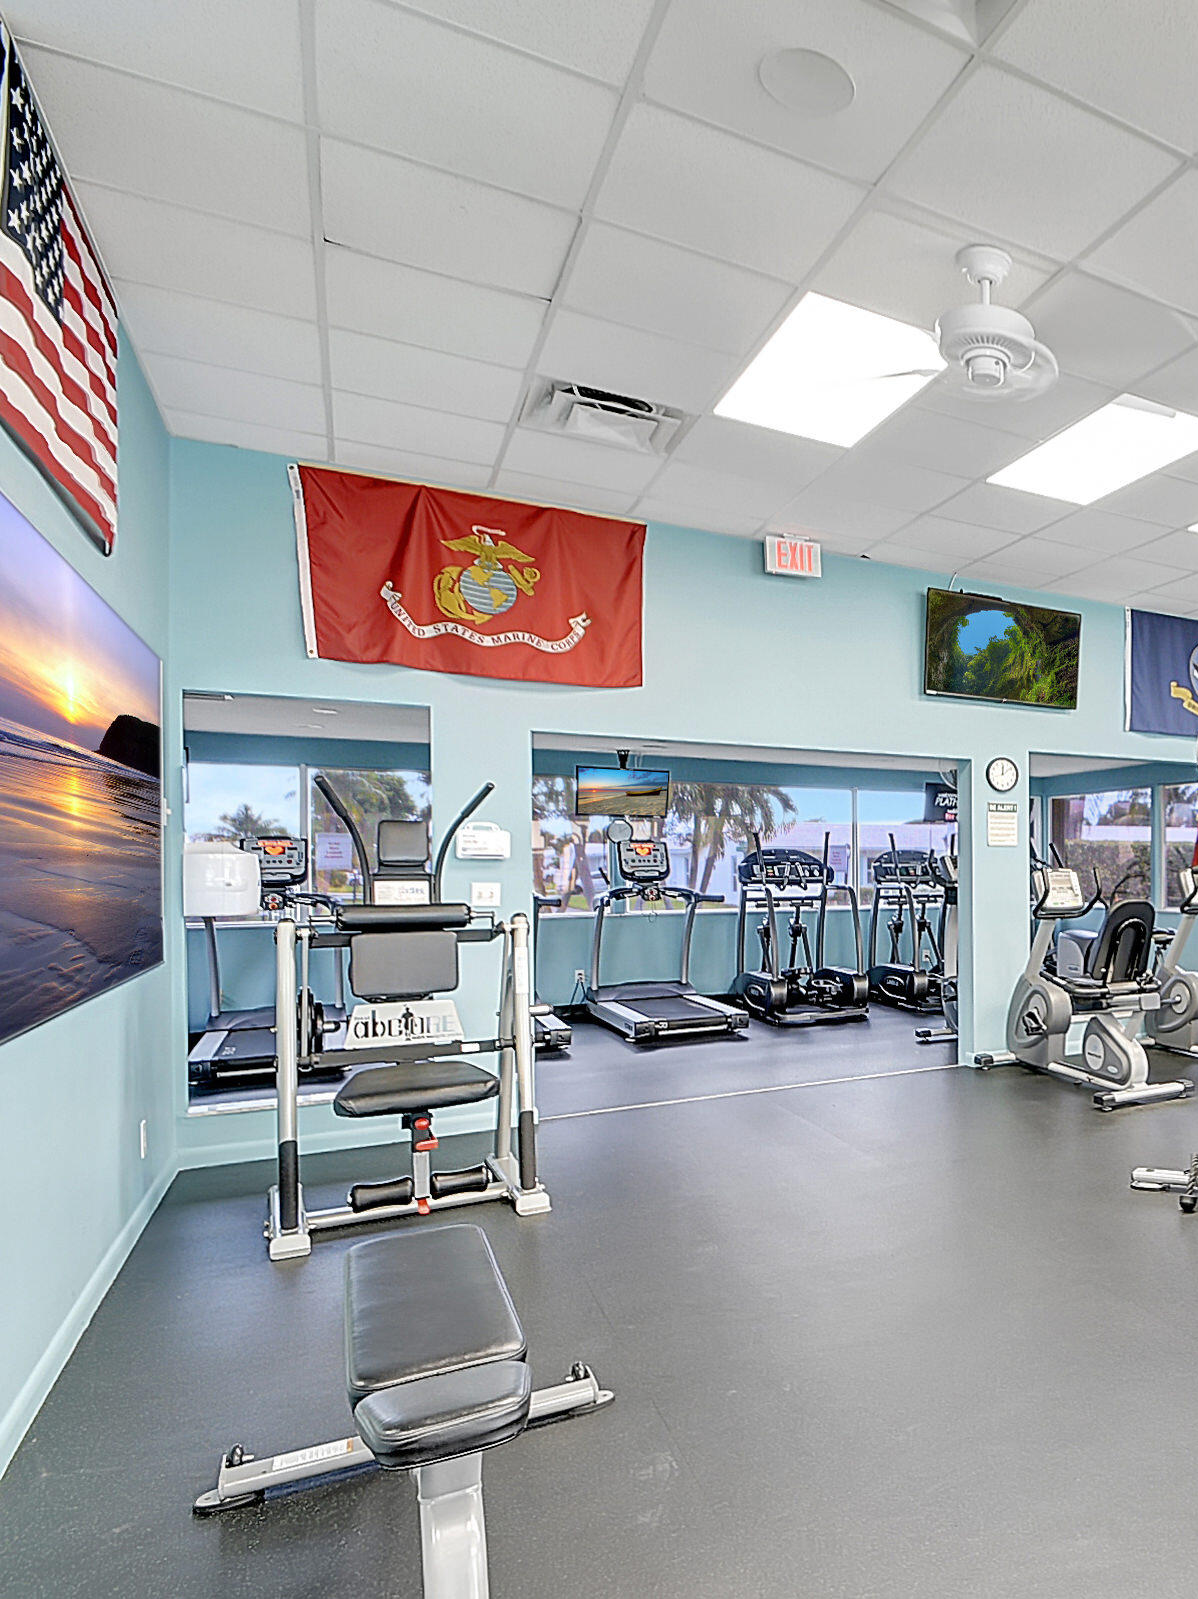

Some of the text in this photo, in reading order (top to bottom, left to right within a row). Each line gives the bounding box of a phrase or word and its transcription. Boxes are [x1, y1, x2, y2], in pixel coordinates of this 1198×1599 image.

[776, 539, 814, 573] EXIT
[389, 601, 582, 652] UNITED STATES MARINE CORPS
